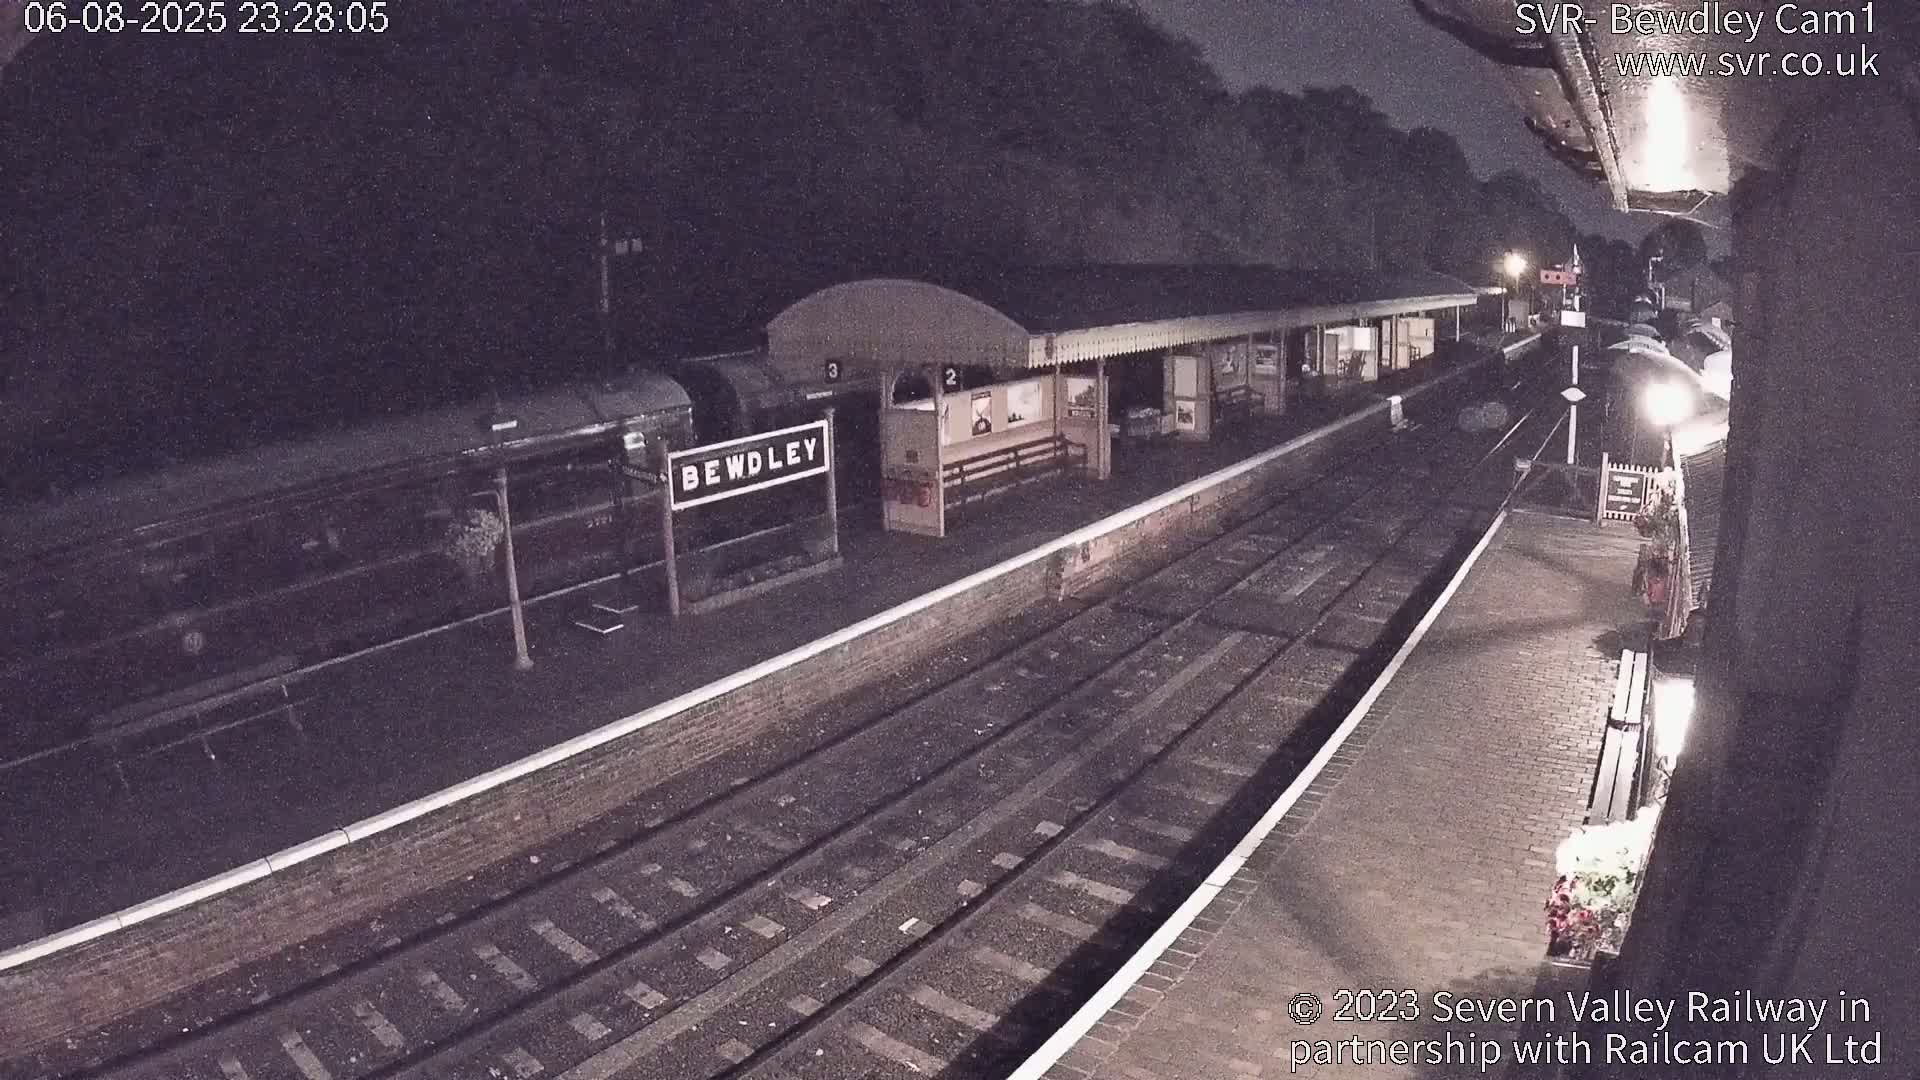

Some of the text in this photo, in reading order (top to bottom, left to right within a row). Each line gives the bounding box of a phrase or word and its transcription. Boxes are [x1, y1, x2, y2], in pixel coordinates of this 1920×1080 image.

[828, 361, 839, 378] 3
[945, 368, 957, 386] 2
[681, 436, 819, 492] BEWDLEY
